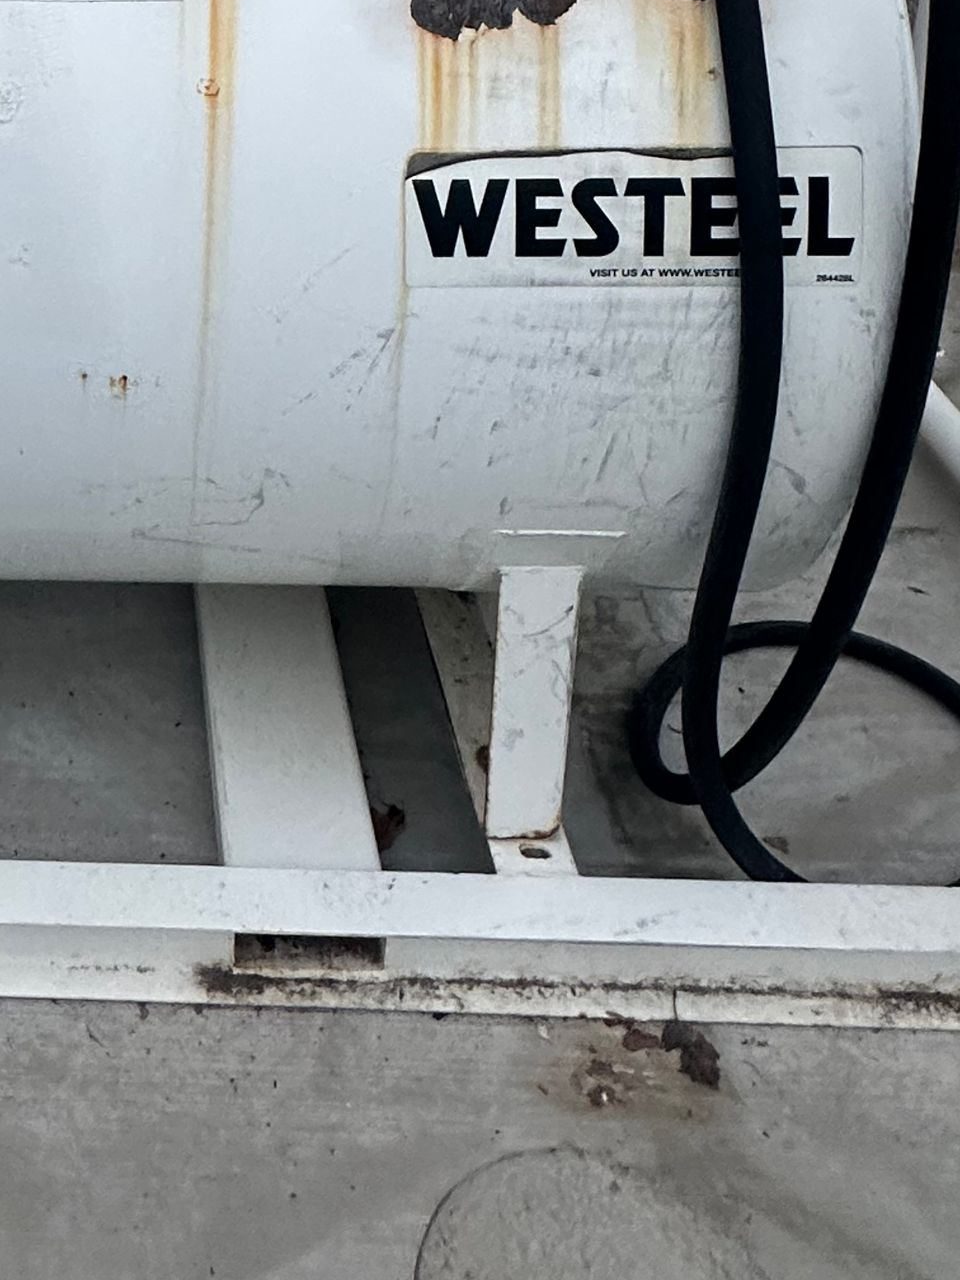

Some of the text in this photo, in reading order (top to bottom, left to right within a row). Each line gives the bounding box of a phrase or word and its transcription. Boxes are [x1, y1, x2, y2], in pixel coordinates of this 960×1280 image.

[590, 268, 618, 278] VISIT
[621, 268, 638, 278] US
[640, 268, 655, 278] AT
